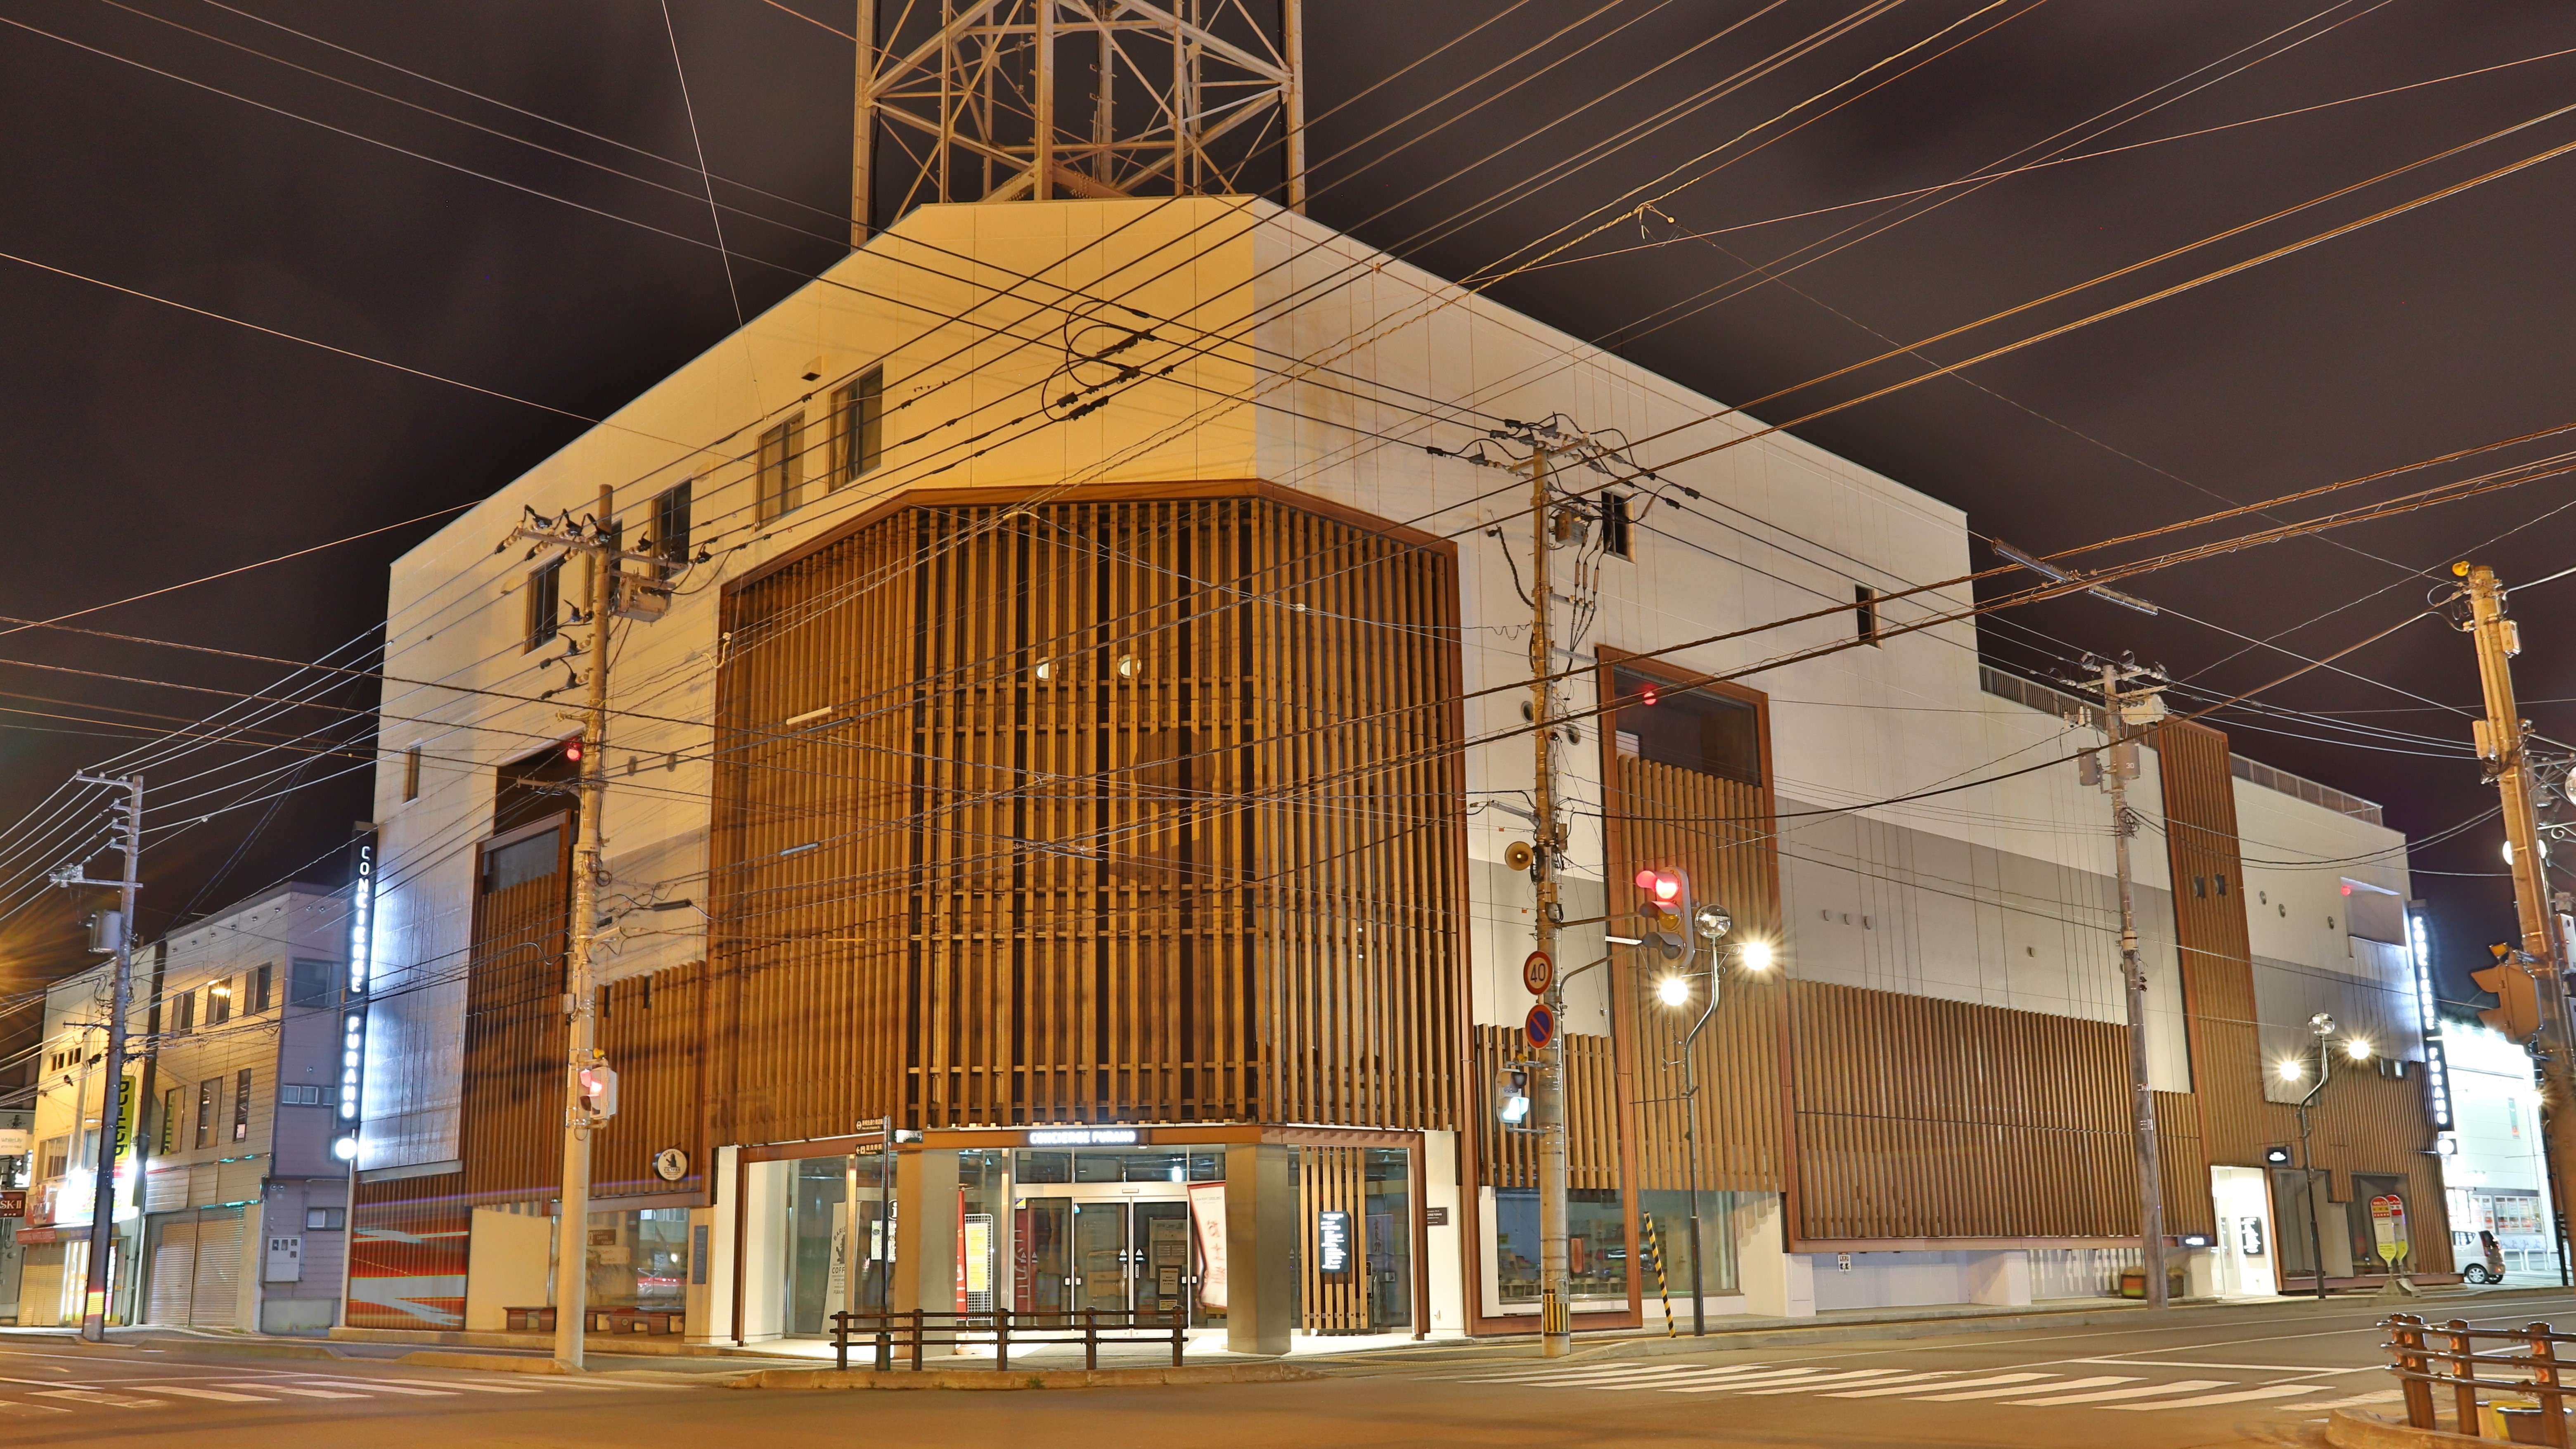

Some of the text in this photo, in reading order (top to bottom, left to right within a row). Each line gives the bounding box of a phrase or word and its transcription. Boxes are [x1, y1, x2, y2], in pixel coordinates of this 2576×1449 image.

[343, 846, 370, 1118] CONCIERGE FURANO
[1530, 963, 1546, 983] 40
[2413, 917, 2448, 1125] CONCIERGE FURANO
[1030, 1131, 1136, 1144] CONCIERGE FURANO
[833, 1226, 846, 1241] BARIS
